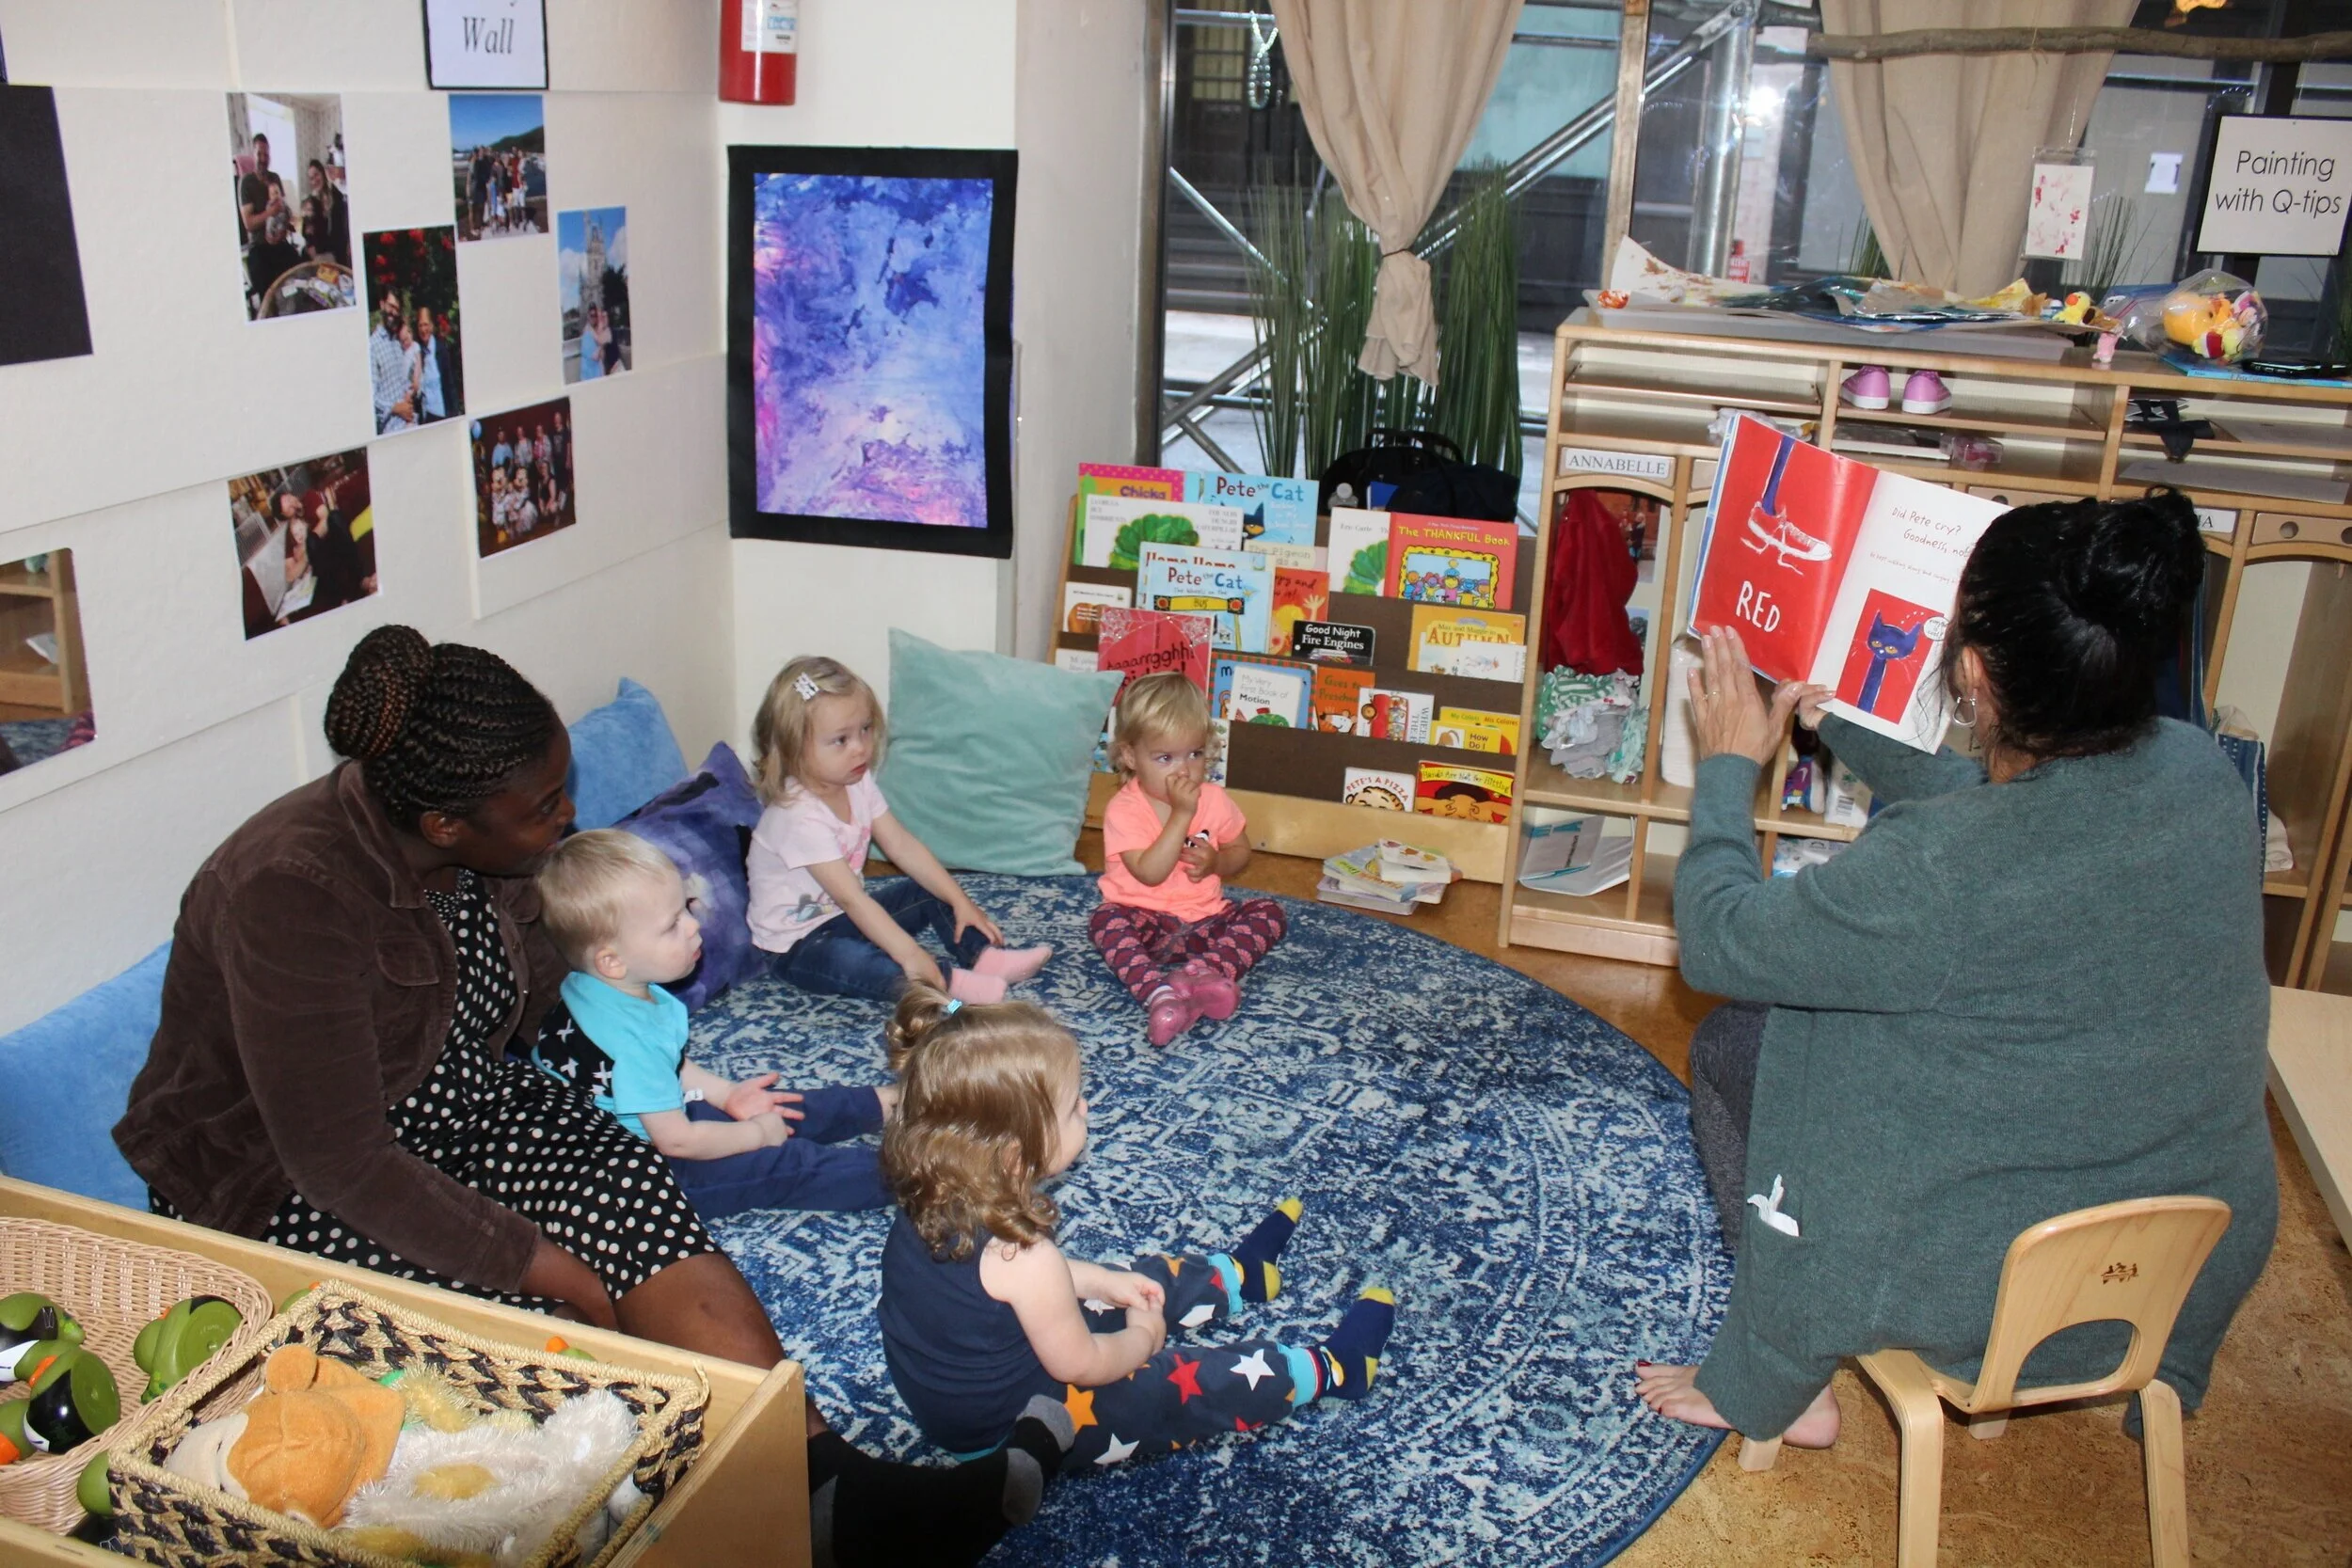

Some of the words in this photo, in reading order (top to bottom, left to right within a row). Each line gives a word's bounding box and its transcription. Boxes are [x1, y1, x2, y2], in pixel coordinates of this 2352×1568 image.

[462, 16, 514, 54] Wall
[2236, 150, 2334, 182] Painting
[2216, 188, 2264, 212] with
[2272, 189, 2342, 219] Q-tips
[1567, 453, 1666, 476] ANNABELLE
[1120, 485, 1167, 500] Chicka
[1216, 476, 1256, 498] Pete
[1271, 483, 1304, 502] Cat
[1891, 507, 1905, 519] Did
[1908, 511, 1931, 527] Pete
[1934, 522, 1962, 535] cry?
[1397, 526, 1419, 537] The
[1423, 528, 1481, 543] THANKFUL
[1485, 533, 1511, 546] Book
[1168, 566, 1201, 585] Pete
[1215, 573, 1243, 589] Cat
[1736, 579, 1780, 633] RED
[1301, 634, 1321, 645] Fire
[1324, 636, 1364, 651] Engines
[1305, 624, 1330, 635] Good
[1332, 626, 1361, 640] Night
[1239, 692, 1270, 706] Motion
[1470, 733, 1488, 742] How
[1470, 741, 1481, 750] Do
[1346, 776, 1373, 793] PETE'S
[1384, 778, 1410, 802] PIZZA
